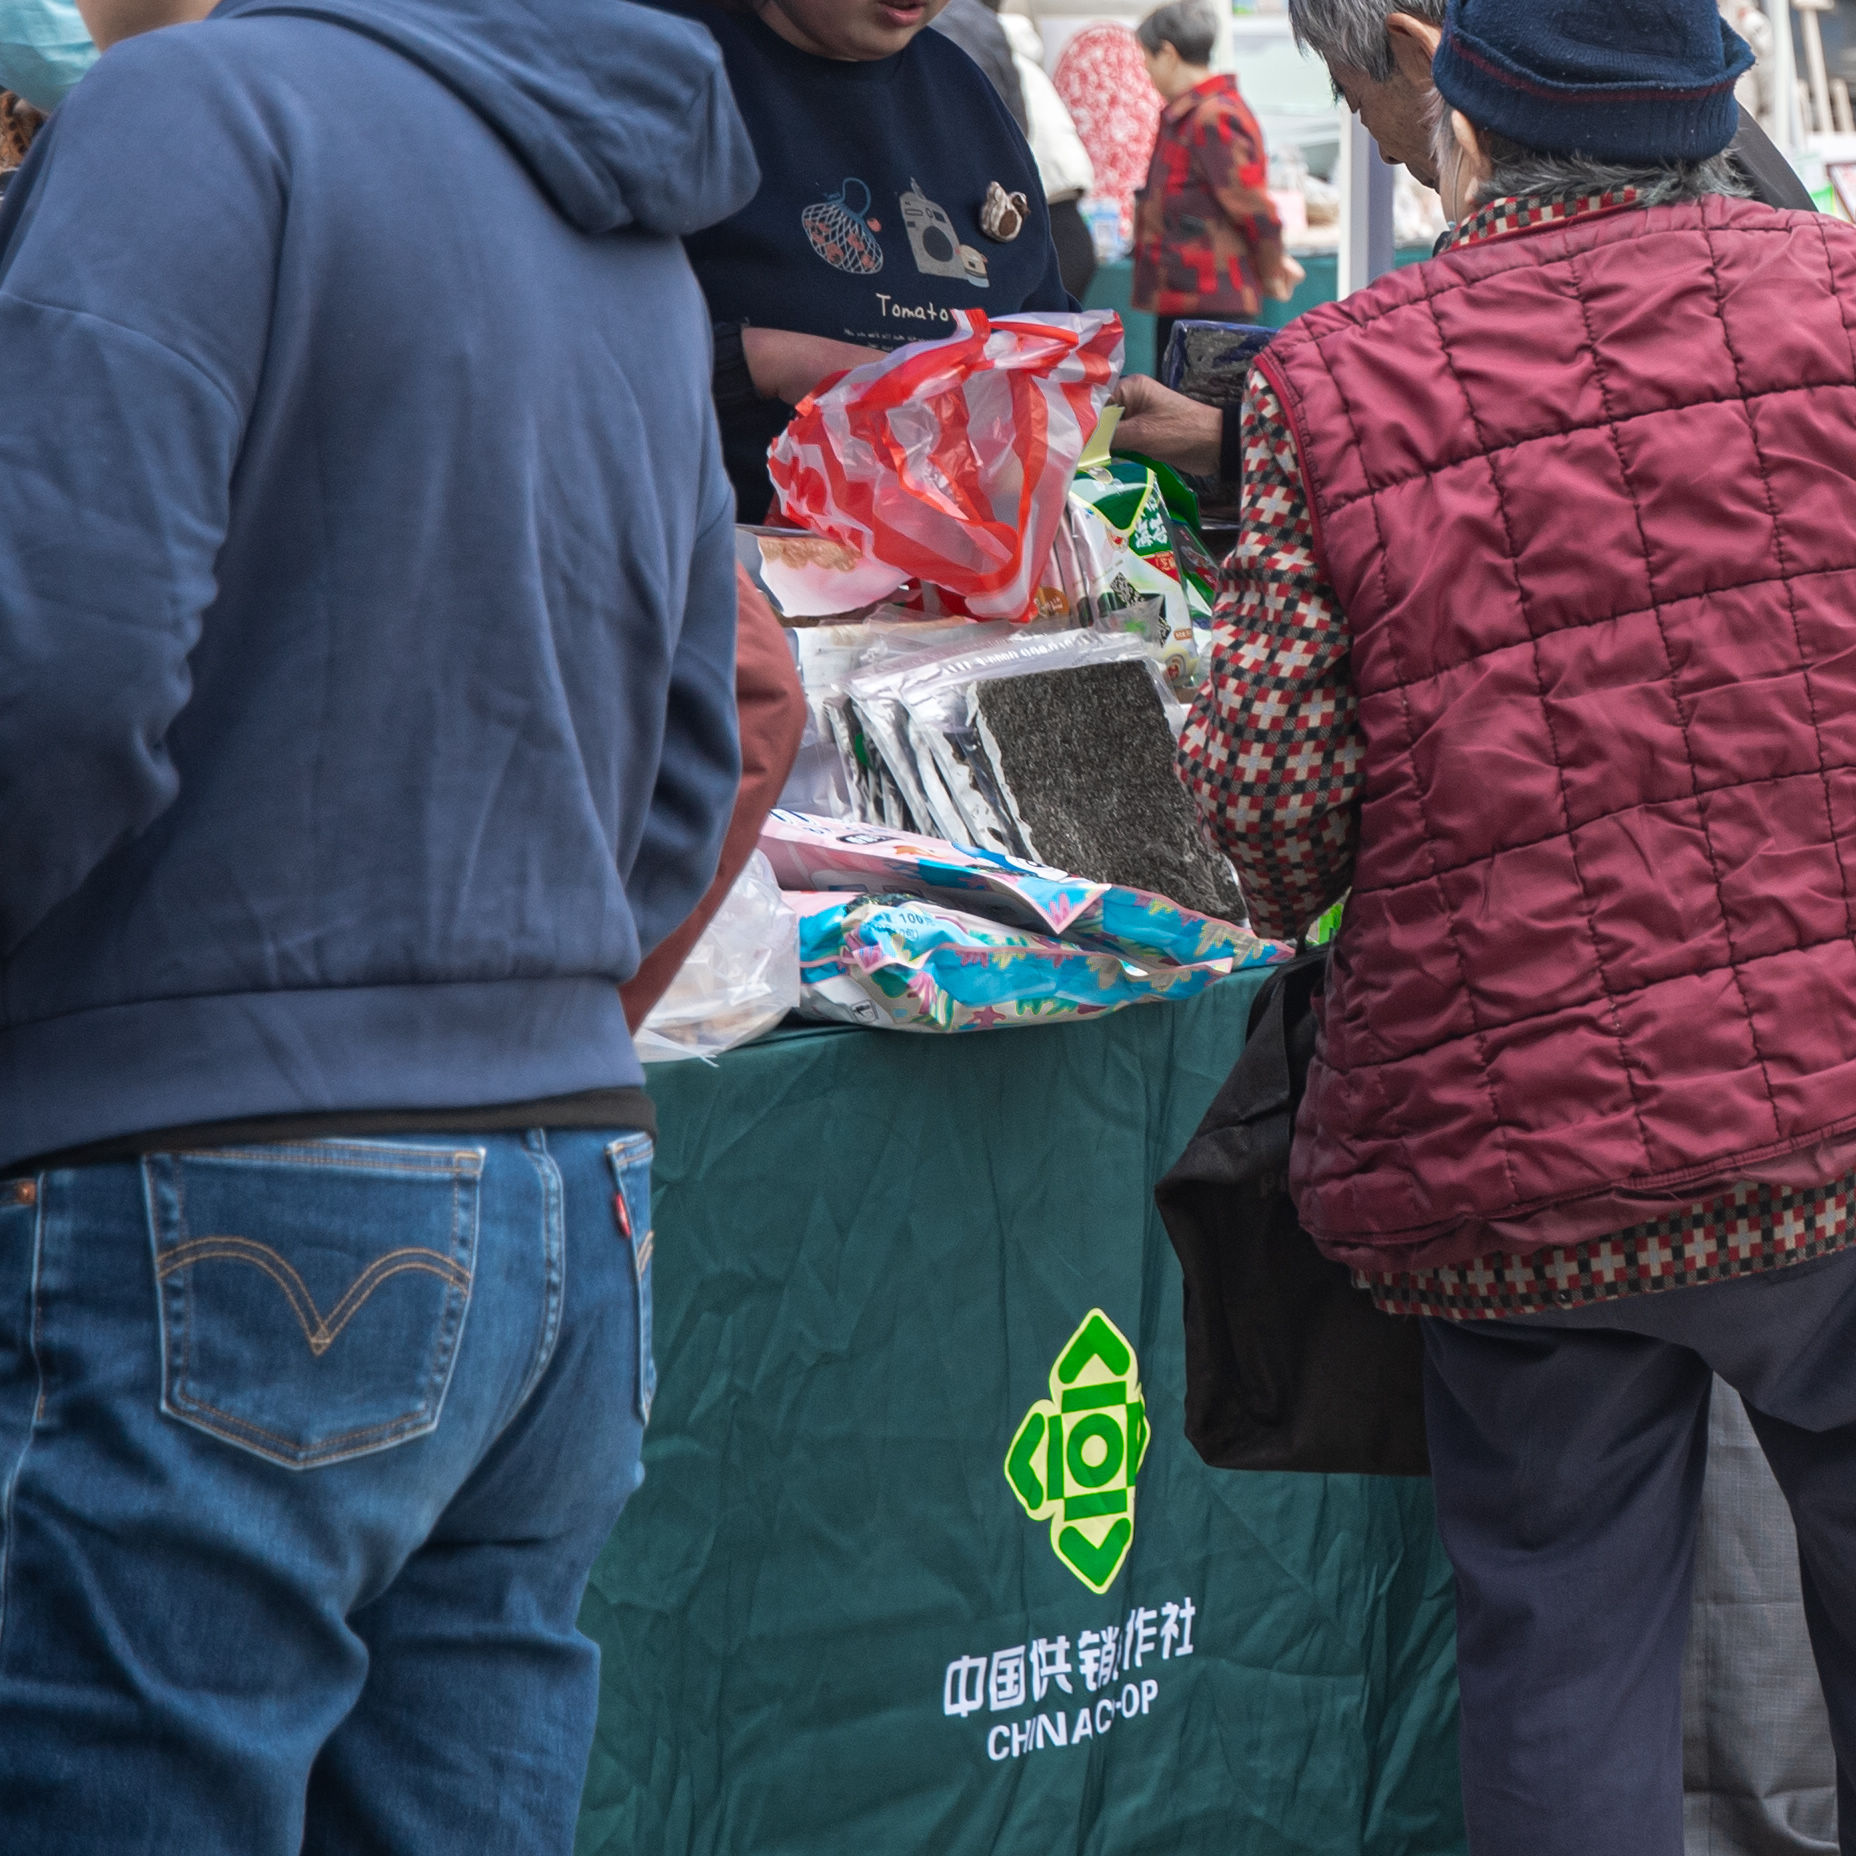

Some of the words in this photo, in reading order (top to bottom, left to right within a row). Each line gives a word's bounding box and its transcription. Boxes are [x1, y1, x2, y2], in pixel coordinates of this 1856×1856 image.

[876, 292, 949, 321] Tomato
[944, 1597, 1195, 1717] 中国供销作社
[1095, 1679, 1158, 1734] C-OP
